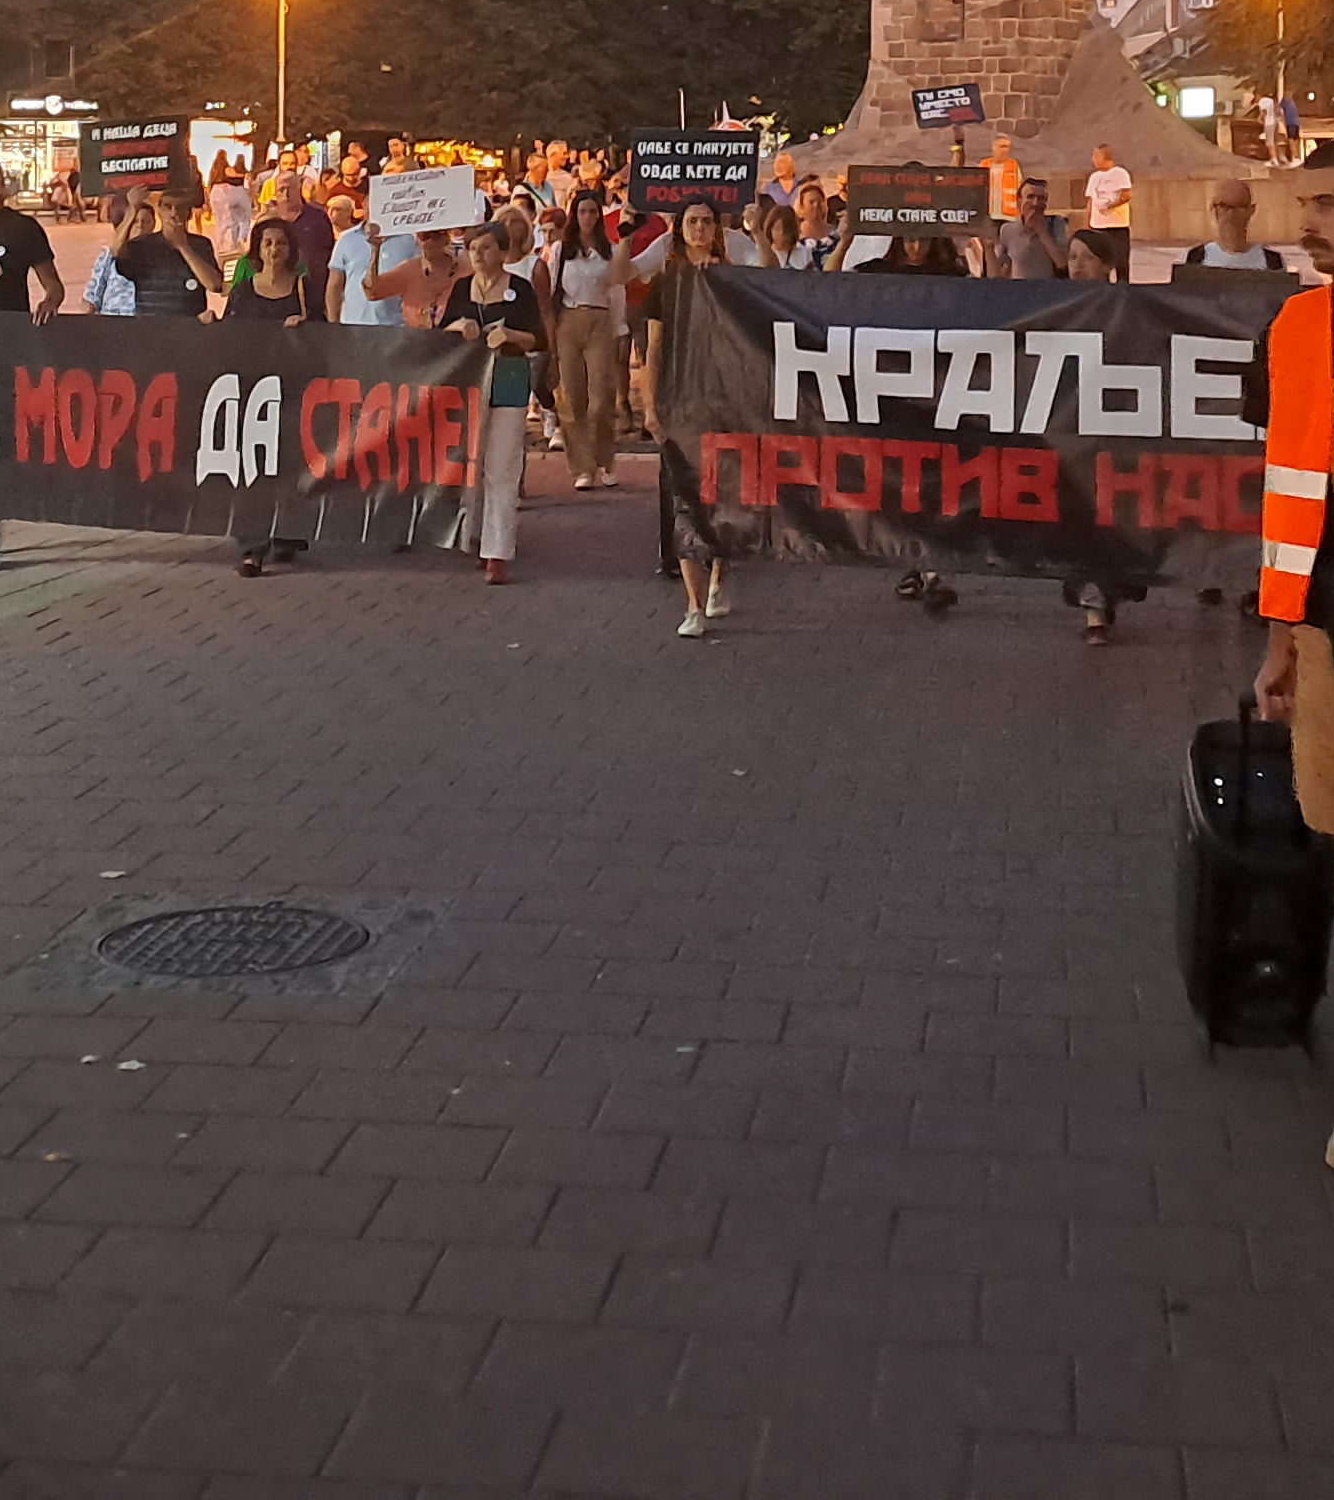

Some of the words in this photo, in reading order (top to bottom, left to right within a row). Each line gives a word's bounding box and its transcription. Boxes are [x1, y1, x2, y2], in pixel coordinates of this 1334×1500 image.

[91, 128, 101, 140] И
[103, 125, 140, 140] НАША
[143, 122, 177, 138] ДЕЦА
[637, 141, 671, 157] ЏАБЕ
[675, 142, 689, 155] СЕ
[693, 142, 754, 157] ПАКУЈЕТЕ
[101, 156, 168, 173] БЕСПЛАТНЕ
[640, 165, 681, 180] ОВДЕ
[725, 164, 748, 181] ДА
[859, 209, 893, 222] НЕКА
[897, 209, 937, 222] СТАНЕ
[773, 321, 1266, 441] КРАЉЕ
[13, 366, 177, 483] МОРА
[196, 373, 281, 489] ДА
[299, 377, 480, 493] СТАНЕ!
[700, 431, 1059, 523] ПРОТИВ
